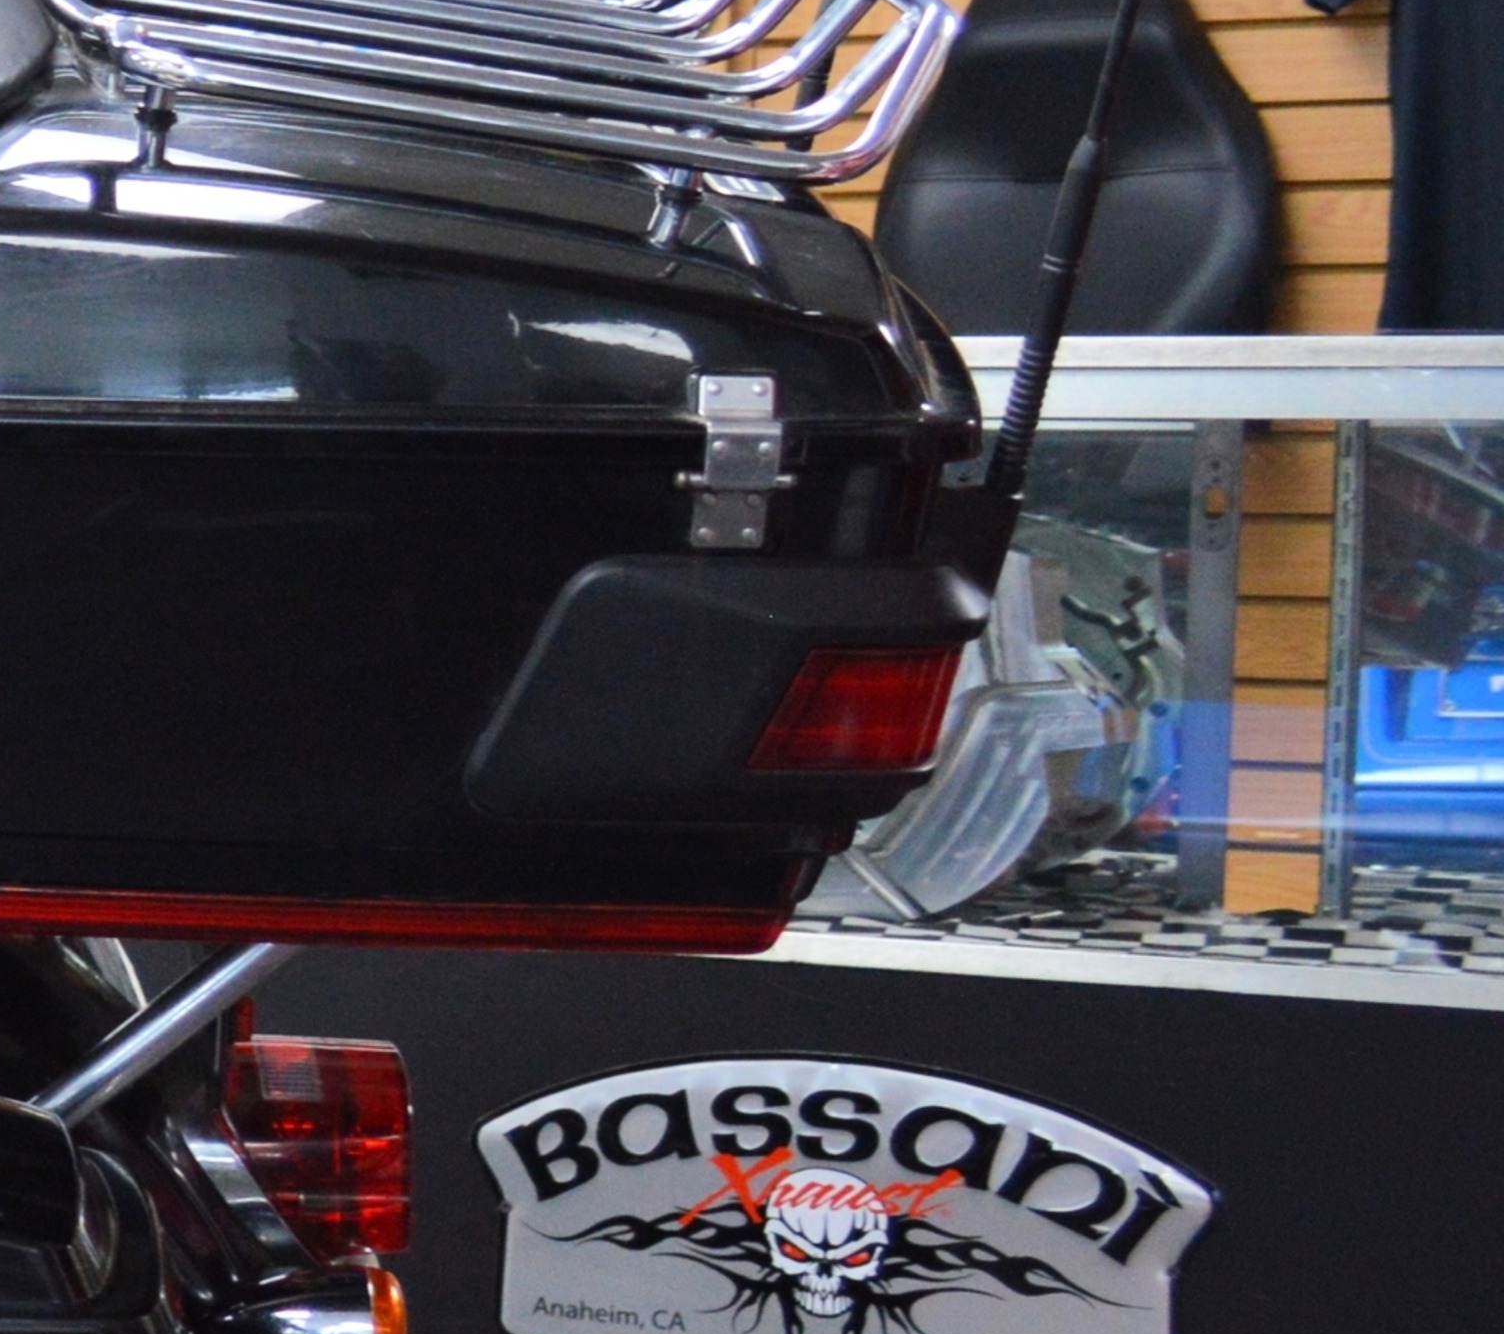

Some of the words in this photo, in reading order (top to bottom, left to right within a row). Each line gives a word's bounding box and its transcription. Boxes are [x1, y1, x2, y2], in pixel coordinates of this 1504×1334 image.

[505, 1085, 1184, 1267] Bassani
[678, 1146, 966, 1229] Xhaust
[533, 1295, 645, 1330] Anaheim,
[651, 1308, 685, 1333] CA
